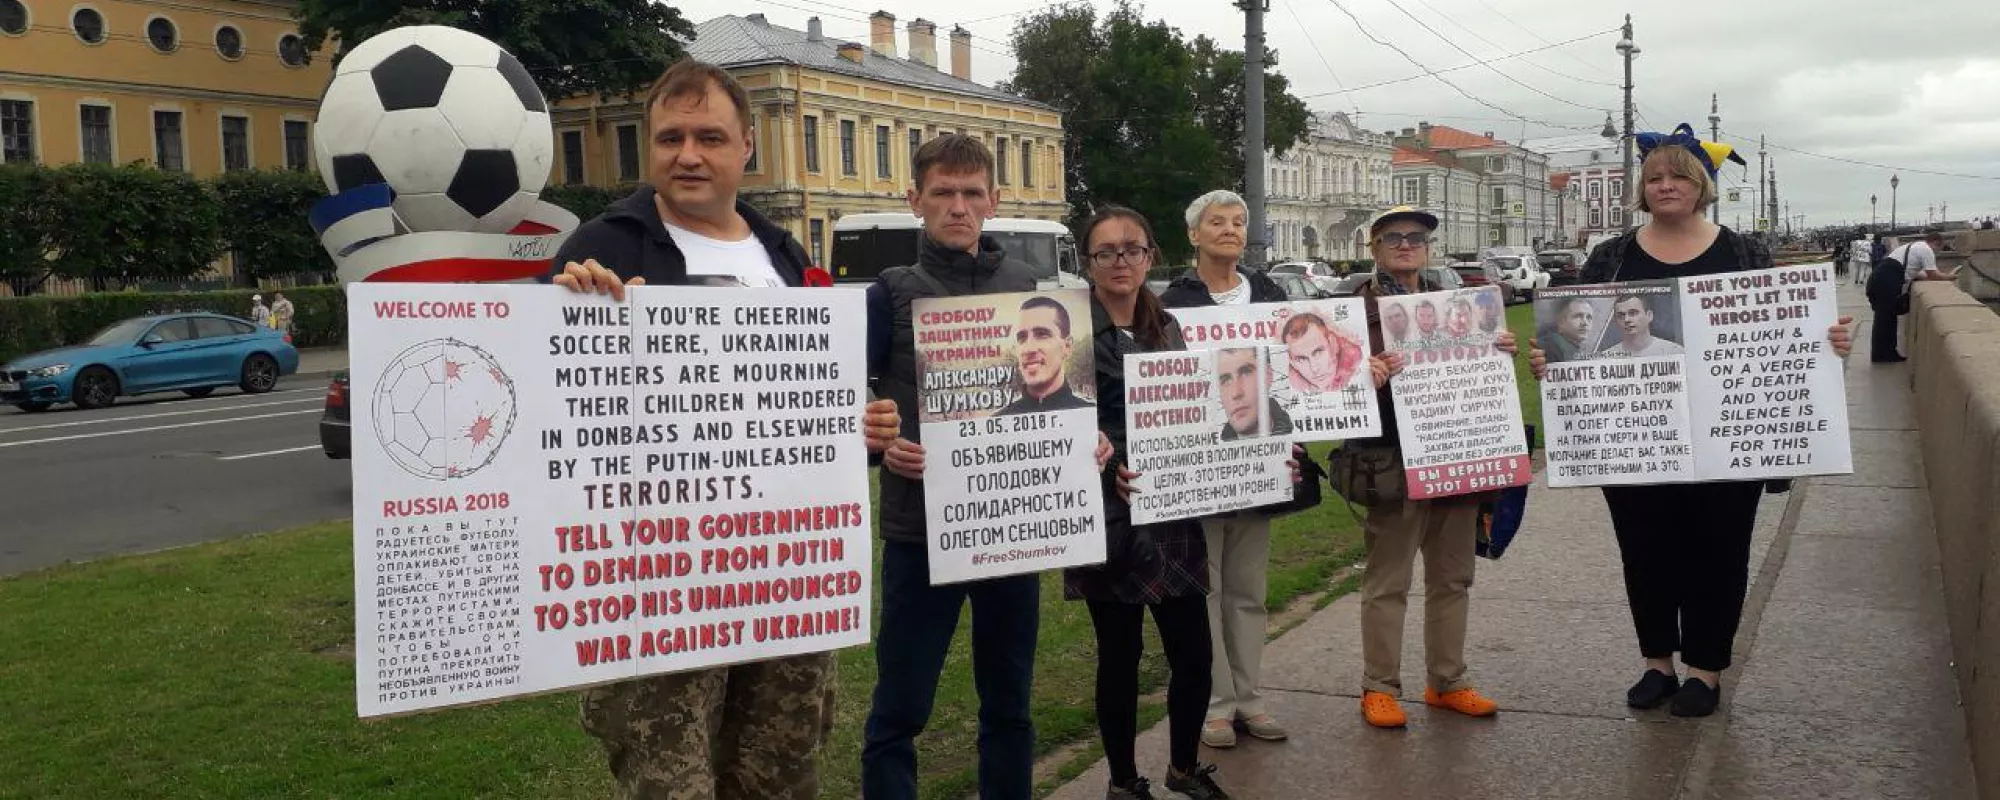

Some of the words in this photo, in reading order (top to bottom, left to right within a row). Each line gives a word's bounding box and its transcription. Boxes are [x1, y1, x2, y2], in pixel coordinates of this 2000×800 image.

[1687, 279, 1723, 294] SAVE
[1729, 275, 1772, 291] YOUR
[1779, 269, 1828, 285] SOUL!
[374, 301, 476, 318] WELCOME
[483, 301, 510, 318] TO
[1701, 294, 1747, 310] DON'T
[1755, 290, 1780, 305] LET
[1787, 287, 1817, 301] THE
[562, 307, 630, 326] WHILE
[645, 307, 721, 325] YOU'RE
[734, 307, 830, 325] CHEERING
[920, 308, 996, 325] СВОБОДУ
[1776, 305, 1810, 320] DIE!
[919, 324, 1012, 344] ЗАЩИТНИКУ
[1182, 321, 1278, 343] СВОБОДУ
[1717, 329, 1785, 344] BALUKH
[1792, 327, 1803, 338] &
[550, 335, 631, 355] SOCCER
[646, 334, 708, 356] HERE,
[721, 333, 829, 352] UKRAINIAN
[926, 345, 1001, 363] УКРАИНЫ
[1703, 345, 1780, 361] SENTSOV
[1787, 341, 1822, 354] ARE
[555, 365, 664, 387] MOTHERS
[679, 364, 720, 384] ARE
[733, 362, 839, 382] MOURNING
[1139, 357, 1199, 378] СВОБОДУ
[1547, 366, 1596, 383] СПАСИТЕ
[1601, 364, 1635, 380] ВАШИ
[1640, 361, 1681, 379] ДУШИ!
[1711, 364, 1733, 376] ON
[1741, 363, 1751, 374] A
[1760, 358, 1816, 372] VERGE
[926, 366, 1015, 391] АЛЕКСАНДРУ
[1722, 377, 1744, 389] OF
[1751, 373, 1806, 387] DEATH
[565, 396, 629, 417] THEIR
[644, 393, 743, 414] CHILDREN
[757, 389, 855, 410] MURDERED
[927, 389, 1014, 413] ШУМКОВУ
[1129, 381, 1211, 404] АЛЕКСАНДРУ
[1547, 388, 1557, 400] НЕ
[1592, 384, 1641, 398] ПОГИБНУТЬ
[1721, 393, 1755, 405] AND
[1764, 388, 1810, 402] YOUR
[1134, 406, 1206, 429] КОСТЕНКО!
[1557, 402, 1626, 416] ВЛАДИМИР
[1631, 399, 1673, 412] БАЛУХ
[1720, 406, 1790, 421] SILENCE
[1798, 404, 1814, 416] IS
[541, 429, 562, 449] IN
[577, 424, 678, 448] DONBASS
[693, 422, 732, 441] AND
[746, 416, 857, 439] ELSEWHERE
[960, 421, 981, 437] 23.
[986, 418, 1008, 434] 05.
[1013, 415, 1046, 431] 2018
[1564, 421, 1573, 431] И
[1577, 417, 1609, 430] ОЛЕГ
[1615, 415, 1668, 430] СЕНЦОВ
[1710, 420, 1828, 437] RESPONSIBLE
[1131, 431, 1220, 454] ИСПОЛЬЗОВАНИЕ
[1557, 435, 1569, 446] НА
[1573, 433, 1601, 444] ГРАНИ
[1604, 432, 1638, 444] СМЕРТИ
[1642, 432, 1648, 441] И
[1652, 429, 1679, 441] ВАШЕ
[1730, 440, 1763, 451] FOR
[1772, 437, 1808, 450] THIS
[549, 459, 577, 479] BY
[592, 456, 631, 477] THE
[646, 445, 836, 473] PUTIN-UNLEASHED
[951, 438, 1073, 468] ОБЪЯВИВШЕМУ
[1136, 450, 1204, 472] ЗАЛОЖНИКОВ
[1550, 449, 1597, 461] МОЛЧАНИЕ
[1601, 447, 1634, 460] ДЕЛАЕТ
[1638, 446, 1656, 458] ВАС
[1659, 444, 1691, 456] ТАКЖЕ
[1730, 456, 1752, 468] AS
[1760, 453, 1812, 467] WELL!
[967, 465, 1061, 493] ГОЛОДОВКУ
[1154, 472, 1187, 491] ЦЕЛЯХ
[1253, 461, 1265, 473] НА
[1419, 469, 1440, 481] ВЫ
[1448, 461, 1502, 477] ВЕРИТЕ
[1510, 459, 1518, 469] В
[1559, 463, 1642, 477] ОТВЕТСТВЕННЫМИ
[1646, 461, 1657, 473] ЗА
[584, 475, 763, 510] TERRORISTS.
[1424, 481, 1462, 494] ЭТОТ
[1471, 473, 1514, 488] БРЕД?
[383, 496, 458, 518] RUSSIA
[465, 492, 510, 511] 2018
[944, 491, 1073, 523] СОЛИДАРНОСТИ
[1077, 490, 1088, 507] С
[1137, 482, 1237, 511] ГОСУДАРСТВЕННОМ
[376, 525, 429, 537] ПОКА
[446, 522, 469, 531] ВЫ
[486, 517, 518, 527] ТУТ
[555, 523, 613, 553] TELL
[620, 517, 690, 546] YOUR
[698, 503, 862, 540] GOVERNMENTS
[940, 526, 1004, 551] ОЛЕГОМ
[1008, 515, 1095, 543] СЕНЦОВЫМ
[376, 545, 460, 560] УКРАИНСКИЕ
[470, 540, 519, 552] МАТЕРИ
[377, 535, 451, 549] РАДУЕТЕСЬ
[377, 556, 468, 572] ОПЛАКИВАЮТ
[478, 552, 519, 562] СВОИХ
[539, 563, 574, 591] TO
[583, 552, 692, 586] DEMAND
[701, 545, 768, 574] FROM
[777, 537, 844, 567] PUTIN
[971, 545, 1067, 565] #FreeShumkov
[439, 565, 492, 579] УБИТЫХ
[503, 563, 519, 572] НА
[376, 582, 439, 597] ДОНБАССЕ
[448, 581, 456, 589] И
[464, 579, 471, 587] В
[479, 574, 519, 586] ДРУГИХ
[377, 596, 428, 609] МЕСТАХ
[439, 585, 519, 602] ПУТИНСКИМИ
[534, 603, 569, 631] TO
[573, 595, 636, 626] STOP
[641, 589, 683, 618] HIS
[688, 570, 862, 612] UNANNOUNCED
[378, 616, 454, 631] СКАЖИТЕ
[467, 608, 519, 621] СВОИМ
[378, 640, 450, 654] ЧТОБЫ
[483, 631, 519, 642] ОНИ
[576, 634, 631, 666] WAR
[640, 620, 745, 657] AGAINST
[753, 606, 860, 642] UKRAINE!
[378, 645, 491, 667] ПОТРЕБОВАЛИ
[503, 642, 519, 651] ОТ
[379, 664, 430, 678] ПУТИНА
[441, 654, 519, 670] ПРЕКРАТИТЬ
[379, 670, 480, 690] НЕОБЪЯВЛЕННУЮ
[380, 687, 437, 703] ПРОТИВ
